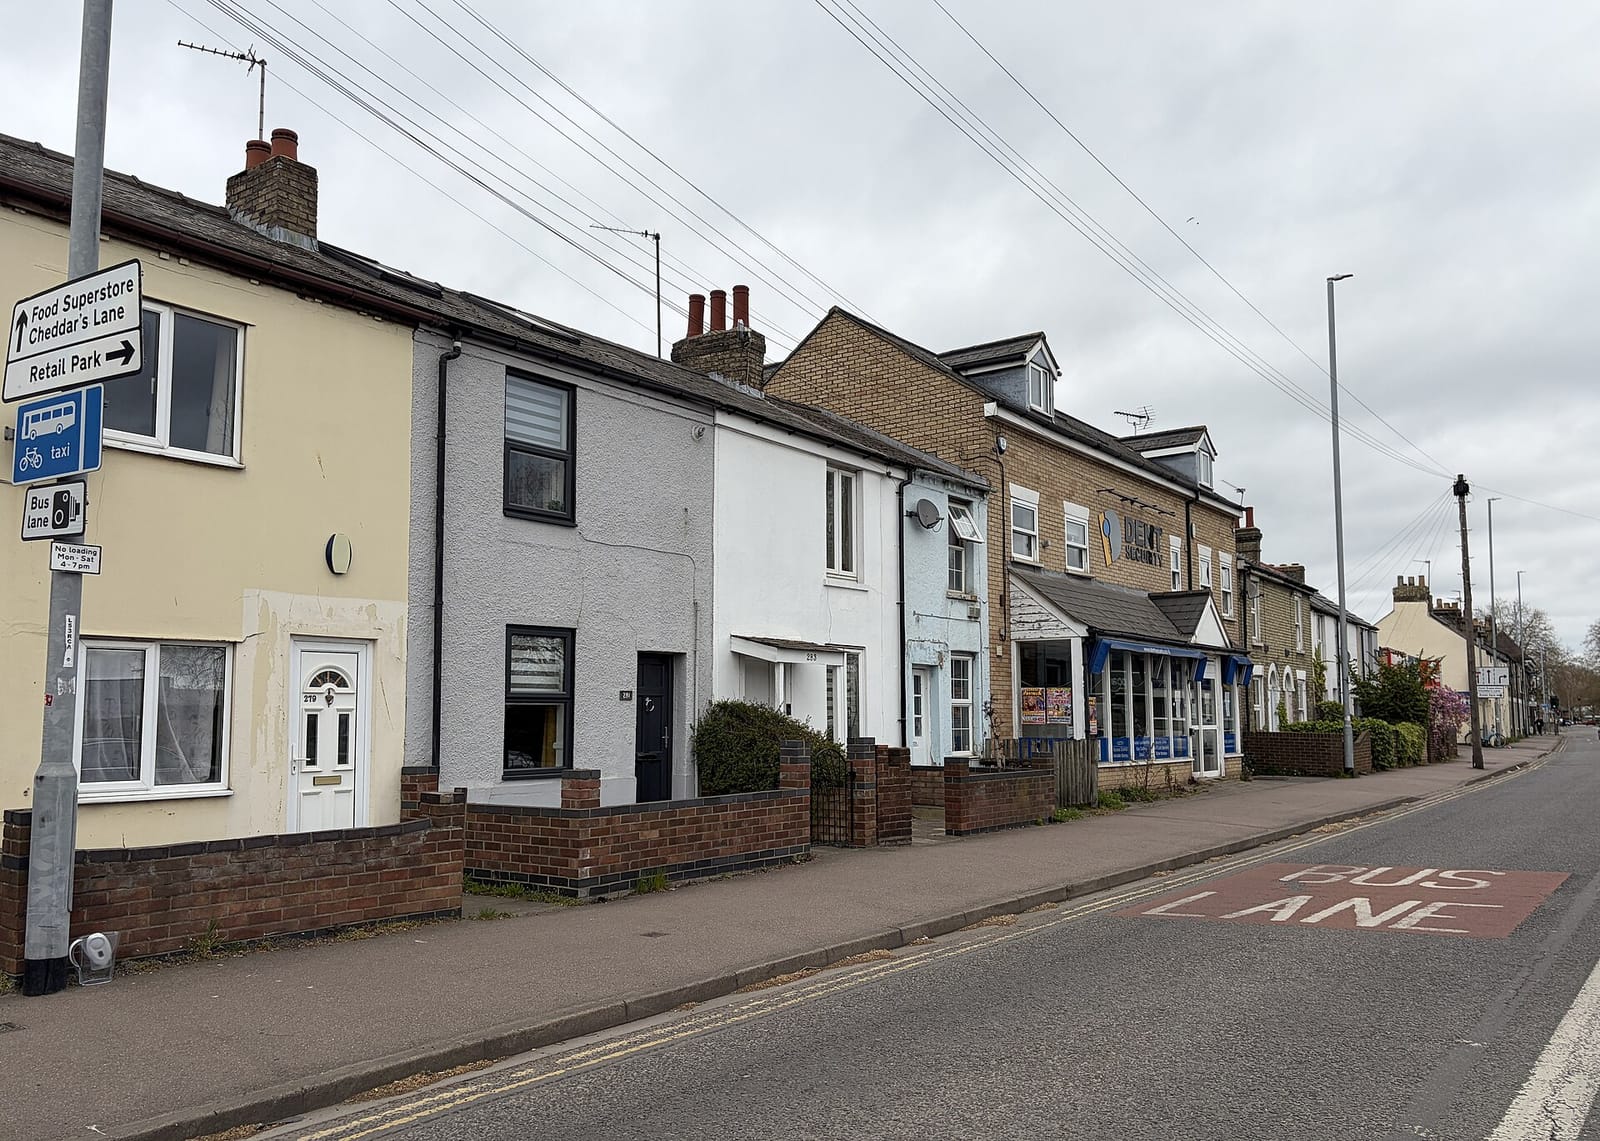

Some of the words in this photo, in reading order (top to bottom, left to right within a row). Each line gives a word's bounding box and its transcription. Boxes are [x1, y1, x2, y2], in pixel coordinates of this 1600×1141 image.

[31, 299, 59, 323] Food
[63, 279, 134, 312] Superstore
[29, 313, 88, 345] Cheddar's
[94, 306, 125, 326] Lane
[29, 358, 66, 383] Retail
[71, 350, 101, 373] Park
[51, 442, 70, 460] taxi
[31, 496, 49, 510] Bus
[27, 515, 48, 528] lane
[1124, 516, 1163, 552] DENT
[69, 547, 97, 556] loading
[1279, 864, 1506, 889] BUS
[1141, 891, 1504, 933] LANE
